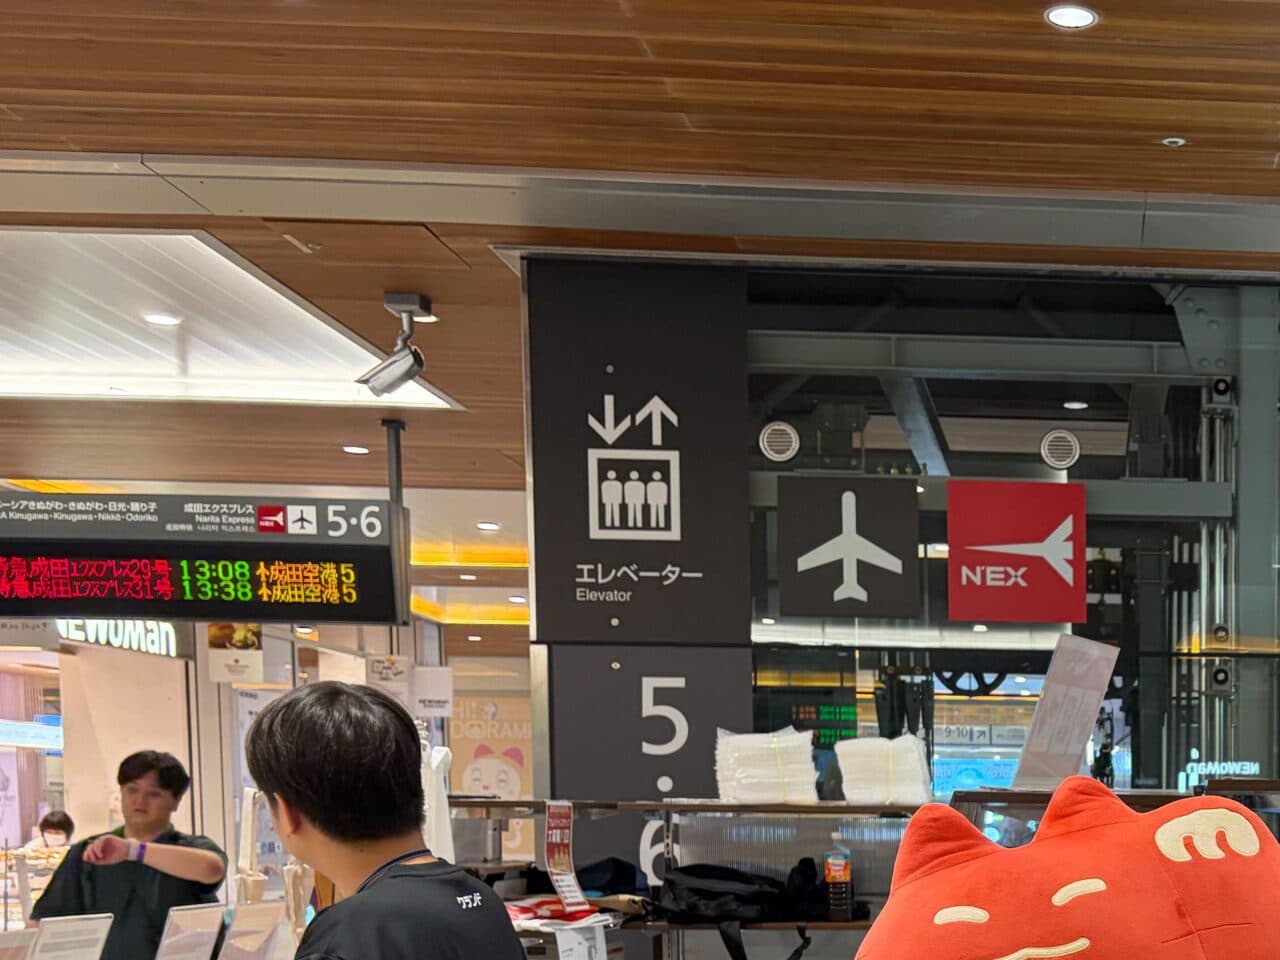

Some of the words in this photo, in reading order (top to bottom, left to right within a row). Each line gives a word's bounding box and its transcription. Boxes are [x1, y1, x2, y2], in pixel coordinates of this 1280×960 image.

[184, 503, 254, 514] 成田エクスプレス
[195, 515, 220, 524] Narita
[222, 516, 255, 526] Express
[180, 560, 251, 581] 13:08
[269, 560, 338, 583] 成田空港
[341, 562, 355, 583] 5
[575, 562, 703, 586] エレベーター
[182, 581, 253, 601] 13:38
[271, 582, 339, 604] 成田空港
[342, 583, 357, 604] 5
[575, 587, 633, 603] Elevator
